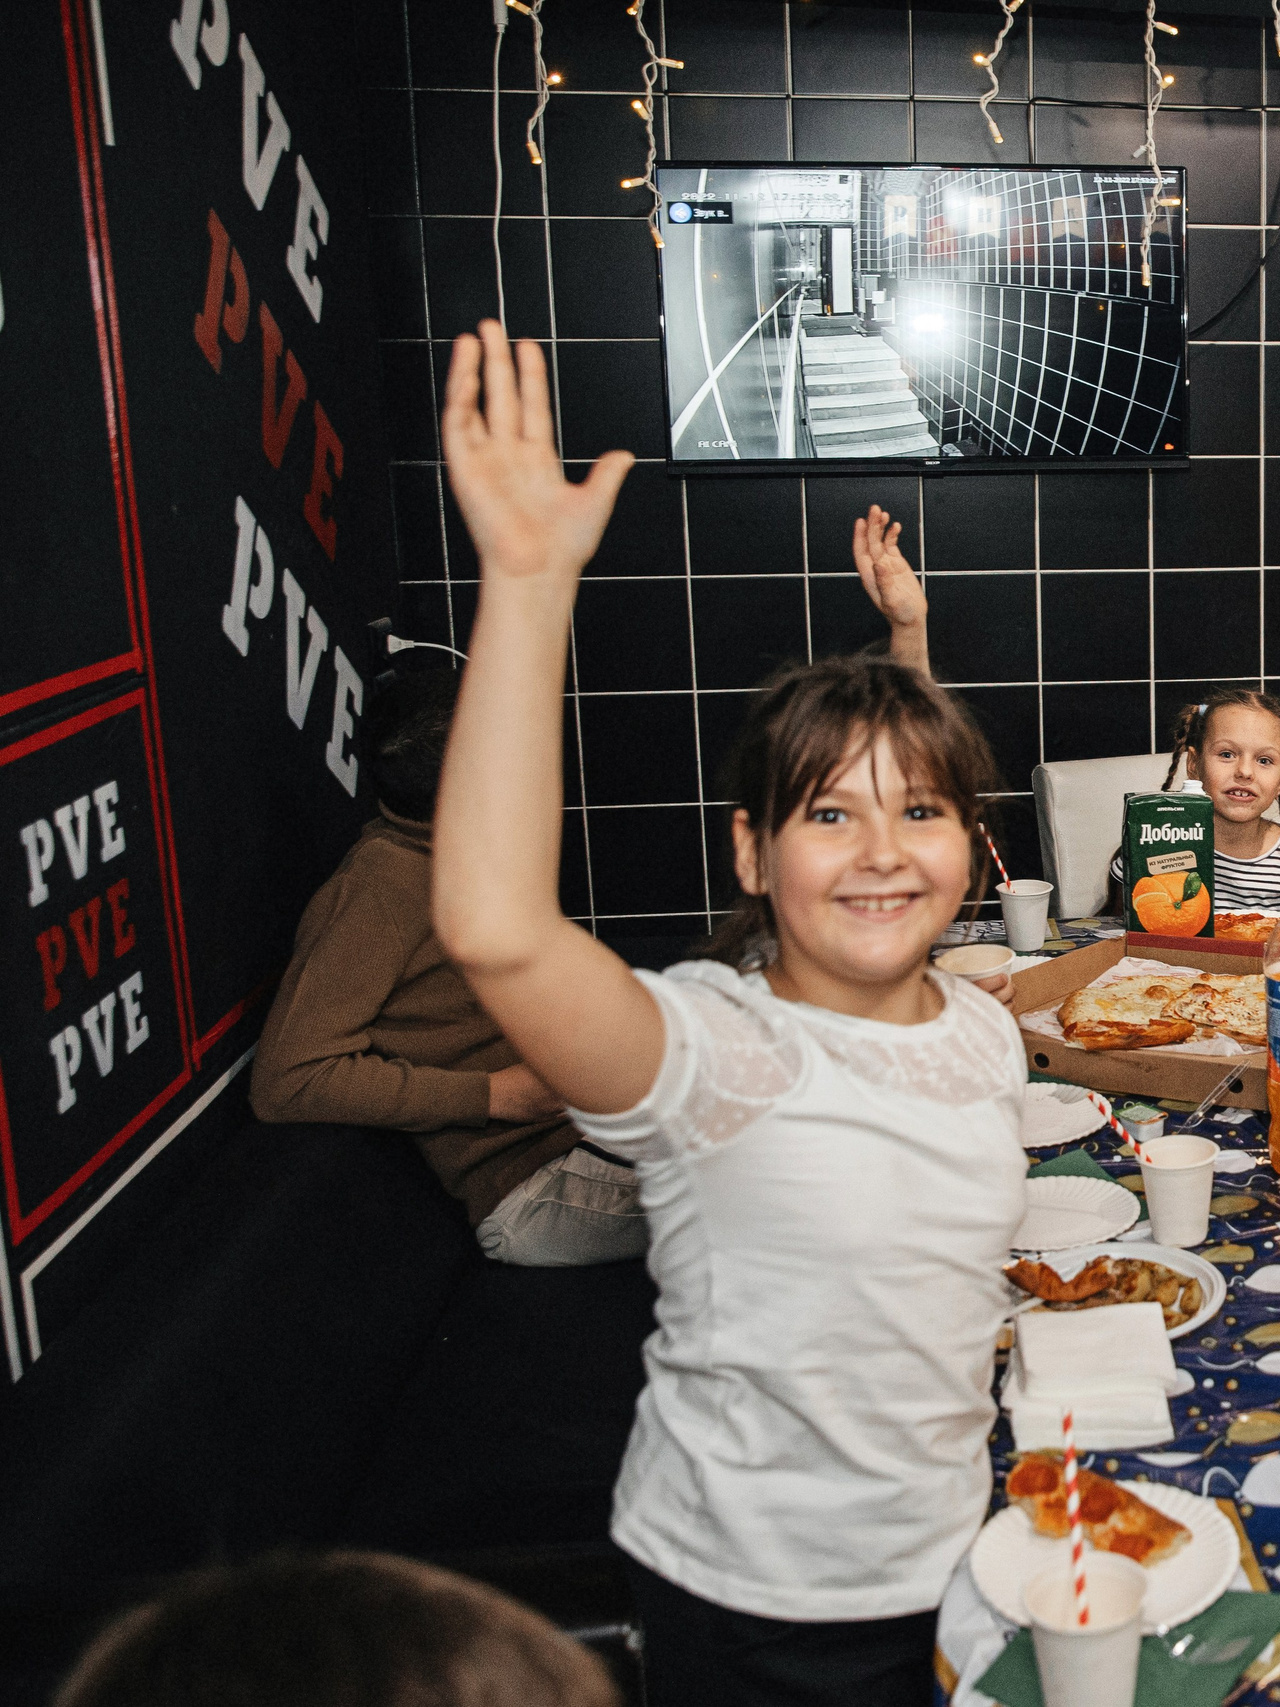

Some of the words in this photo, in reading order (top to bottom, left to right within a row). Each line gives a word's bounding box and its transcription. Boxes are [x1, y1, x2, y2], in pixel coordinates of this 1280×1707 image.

[194, 207, 345, 563] PVE
[222, 494, 364, 798] PVE
[20, 780, 126, 909] PVE
[1139, 822, 1204, 845] Добрый
[1157, 854, 1194, 865] НАТУРАЛЬНЫХ
[1160, 861, 1186, 870] ФРУКТОВ
[35, 878, 136, 1012] PVE
[48, 971, 150, 1115] PVE
